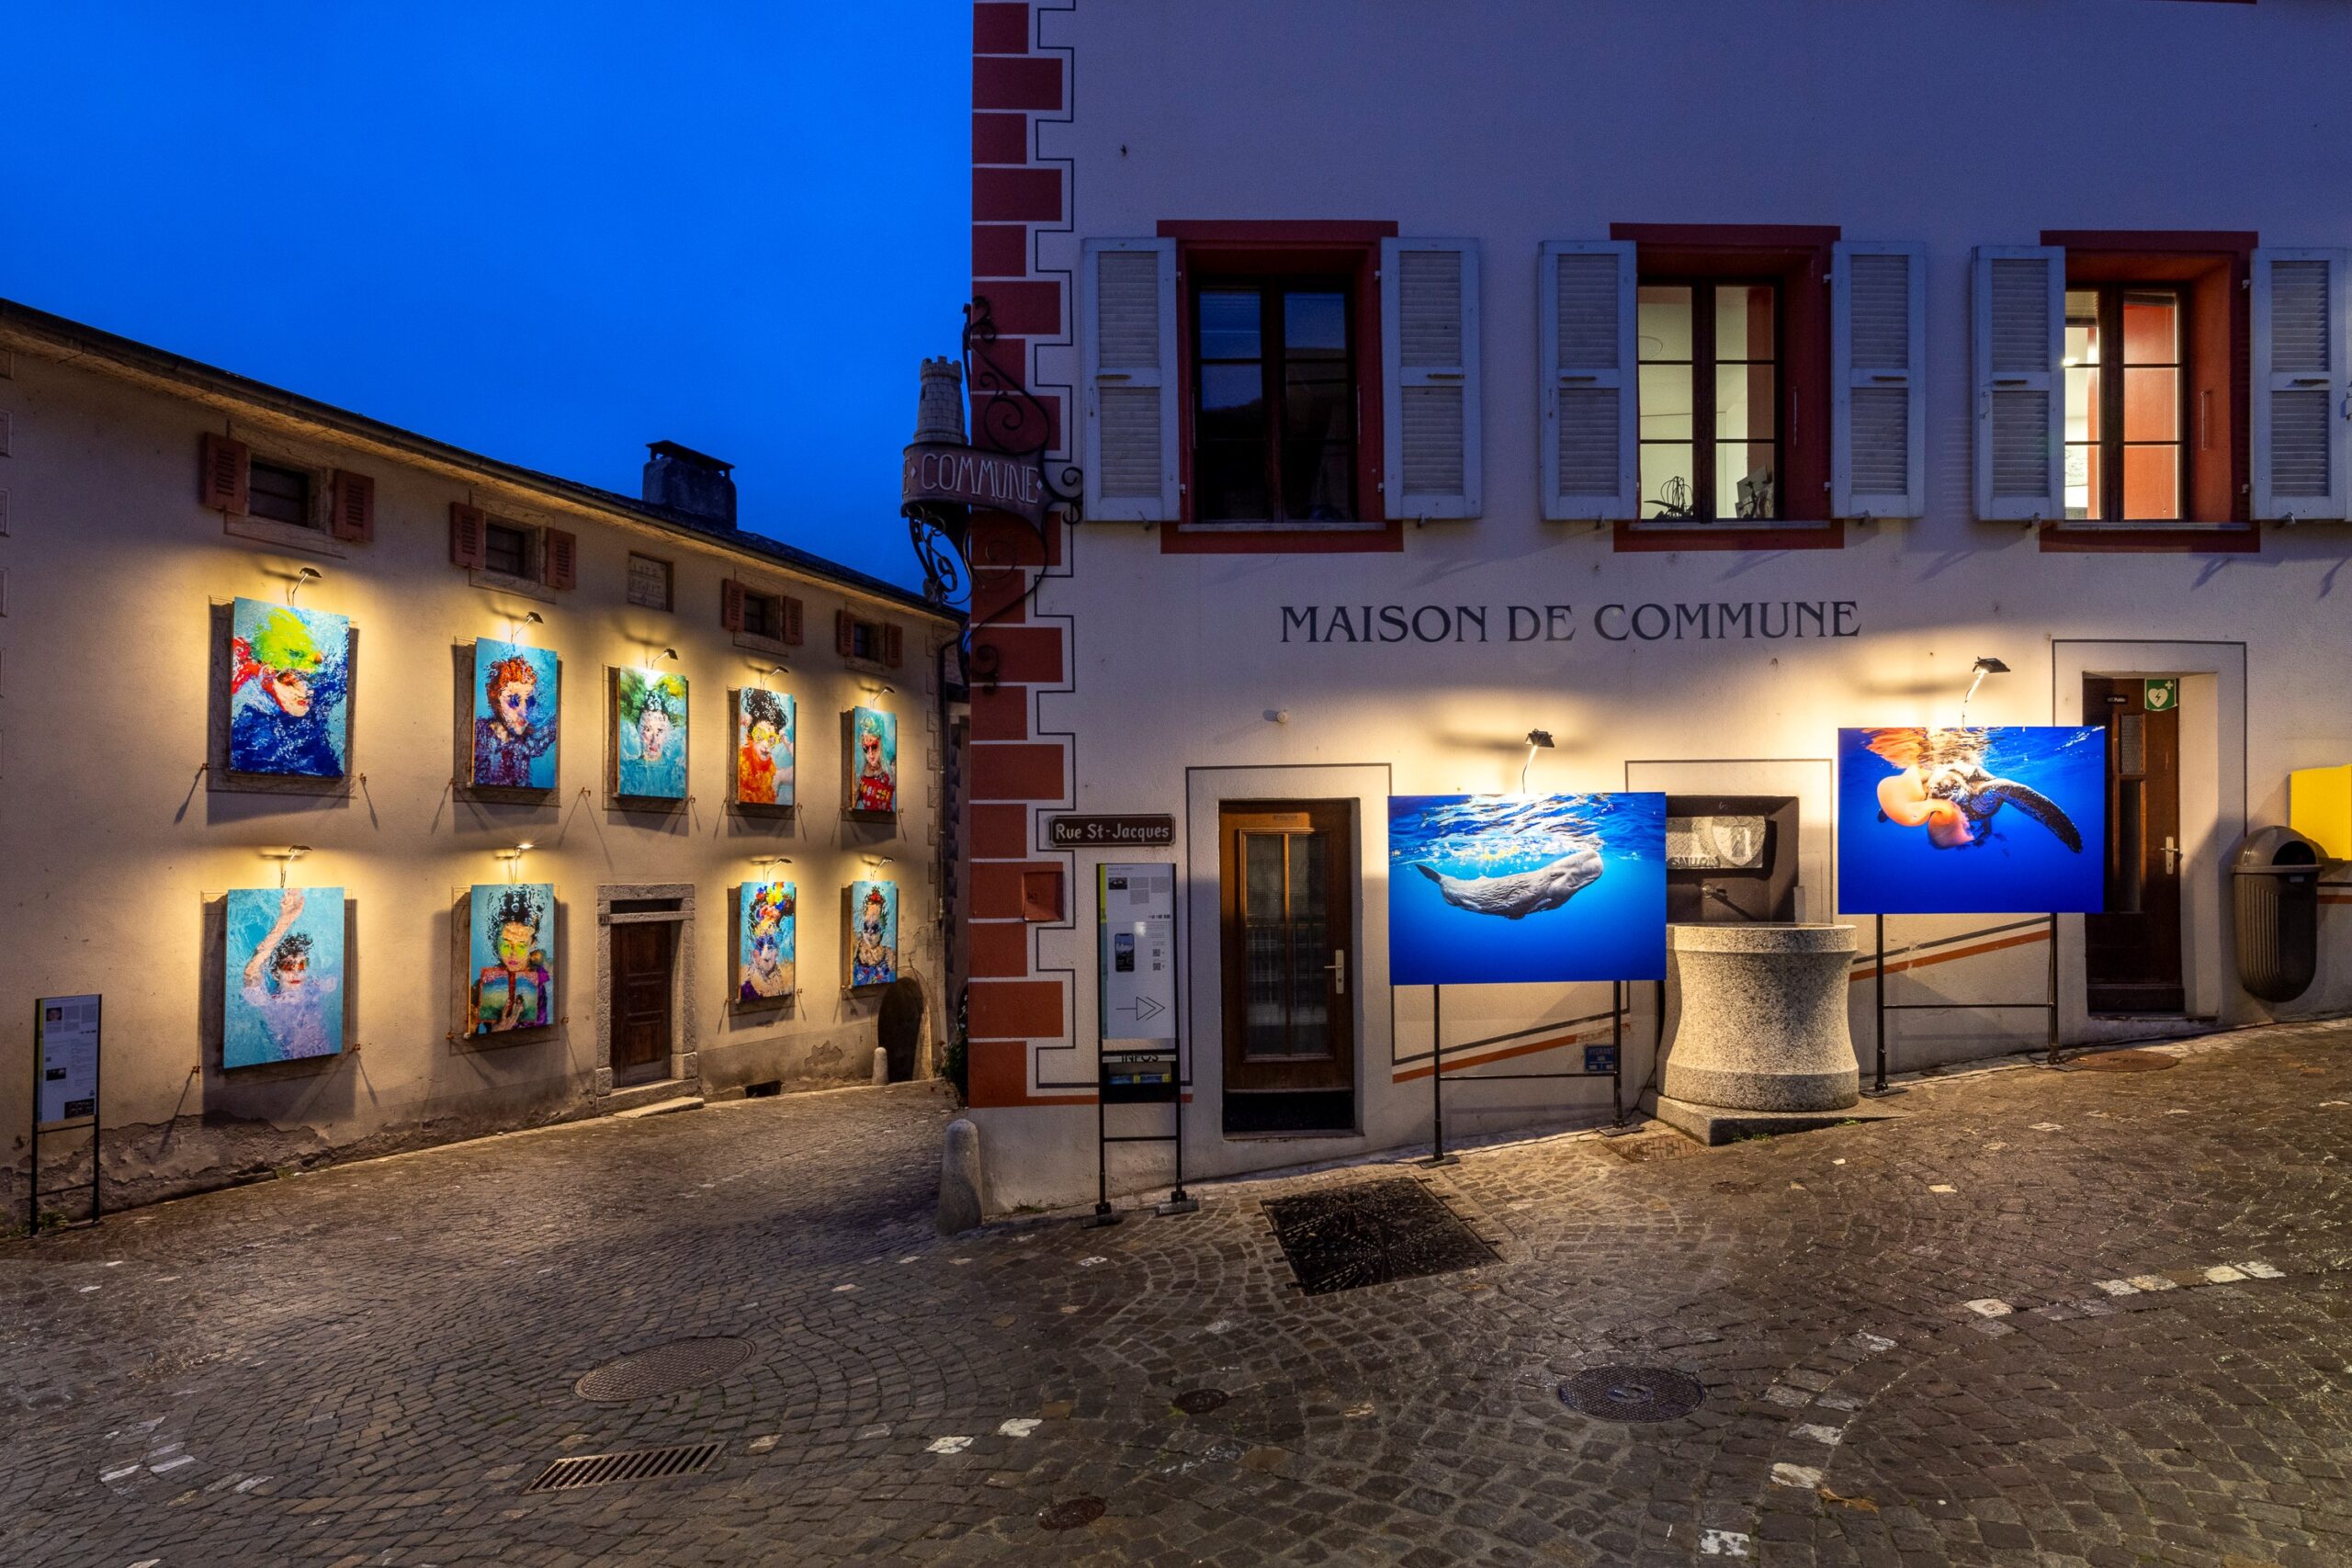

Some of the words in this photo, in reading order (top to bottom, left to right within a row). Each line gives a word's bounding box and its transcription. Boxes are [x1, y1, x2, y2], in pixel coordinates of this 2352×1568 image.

[922, 453, 1038, 503] COMMUNE
[1280, 604, 1487, 643] MAISON
[1508, 604, 1577, 642] DE
[1593, 601, 1861, 641] COMMUNE
[1055, 823, 1082, 840] Rue
[1087, 823, 1170, 842] St-Jacques
